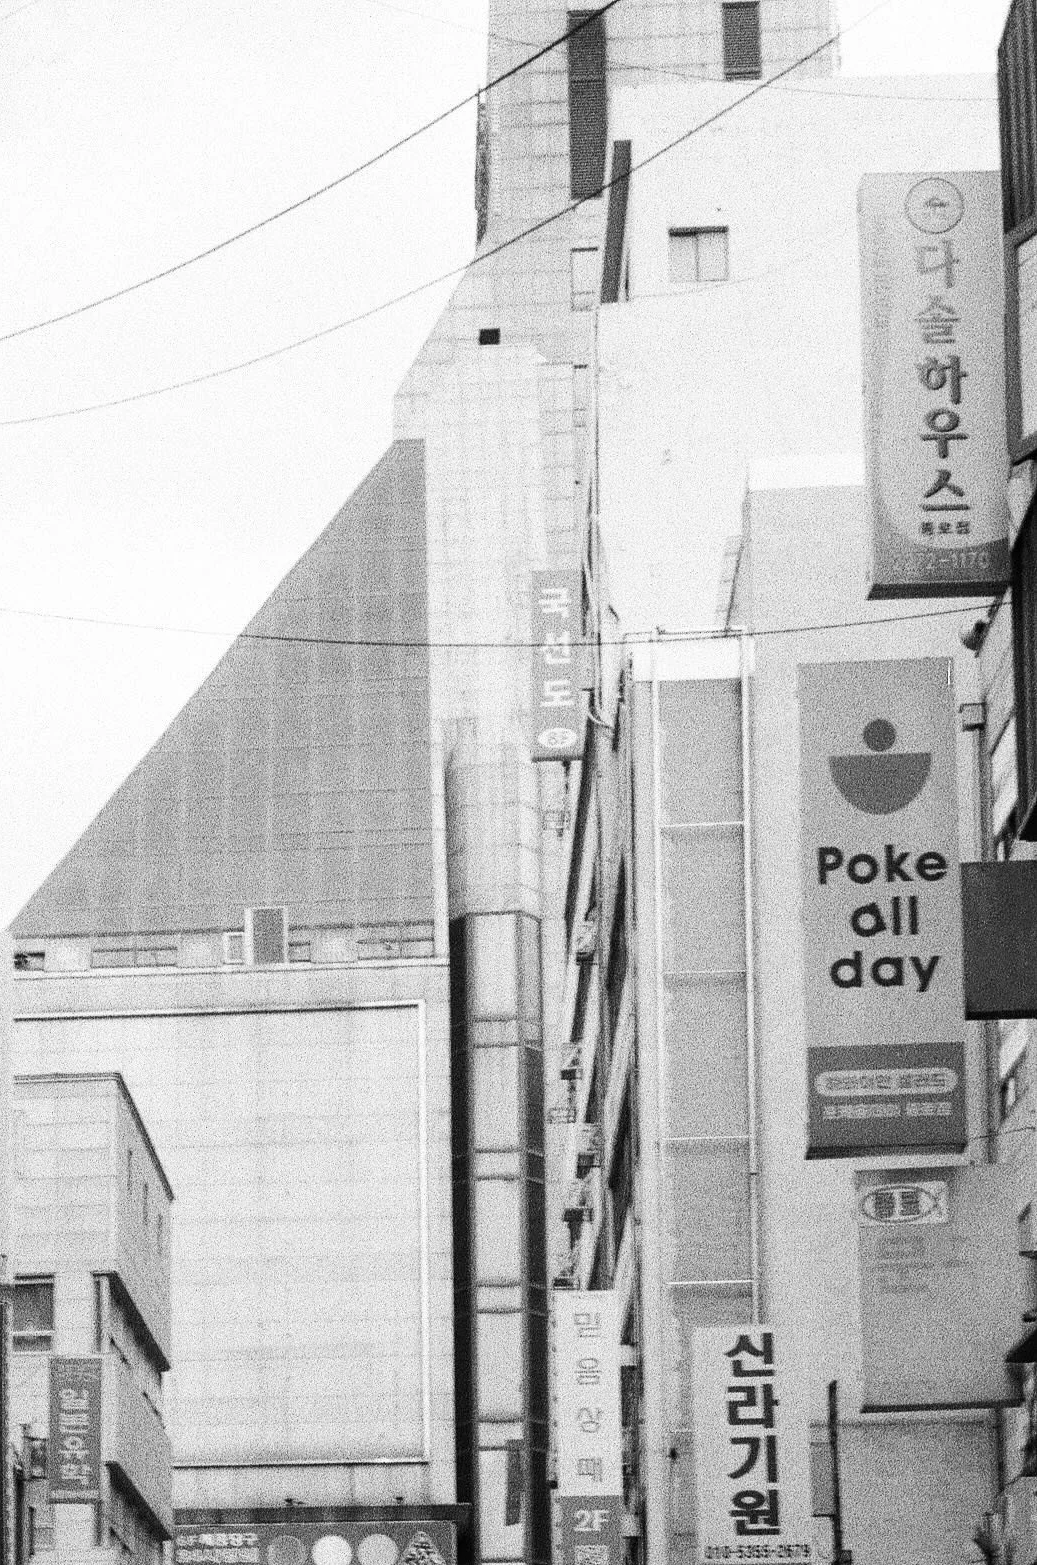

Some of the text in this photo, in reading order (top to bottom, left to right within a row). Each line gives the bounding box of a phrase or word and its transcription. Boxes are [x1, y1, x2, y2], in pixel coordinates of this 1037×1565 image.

[817, 844, 948, 885] Poke
[850, 895, 920, 938] all
[829, 949, 940, 993] day
[58, 1387, 93, 1486] 일본유학
[724, 1331, 782, 1537] 신라기원
[573, 1509, 609, 1533] 2F
